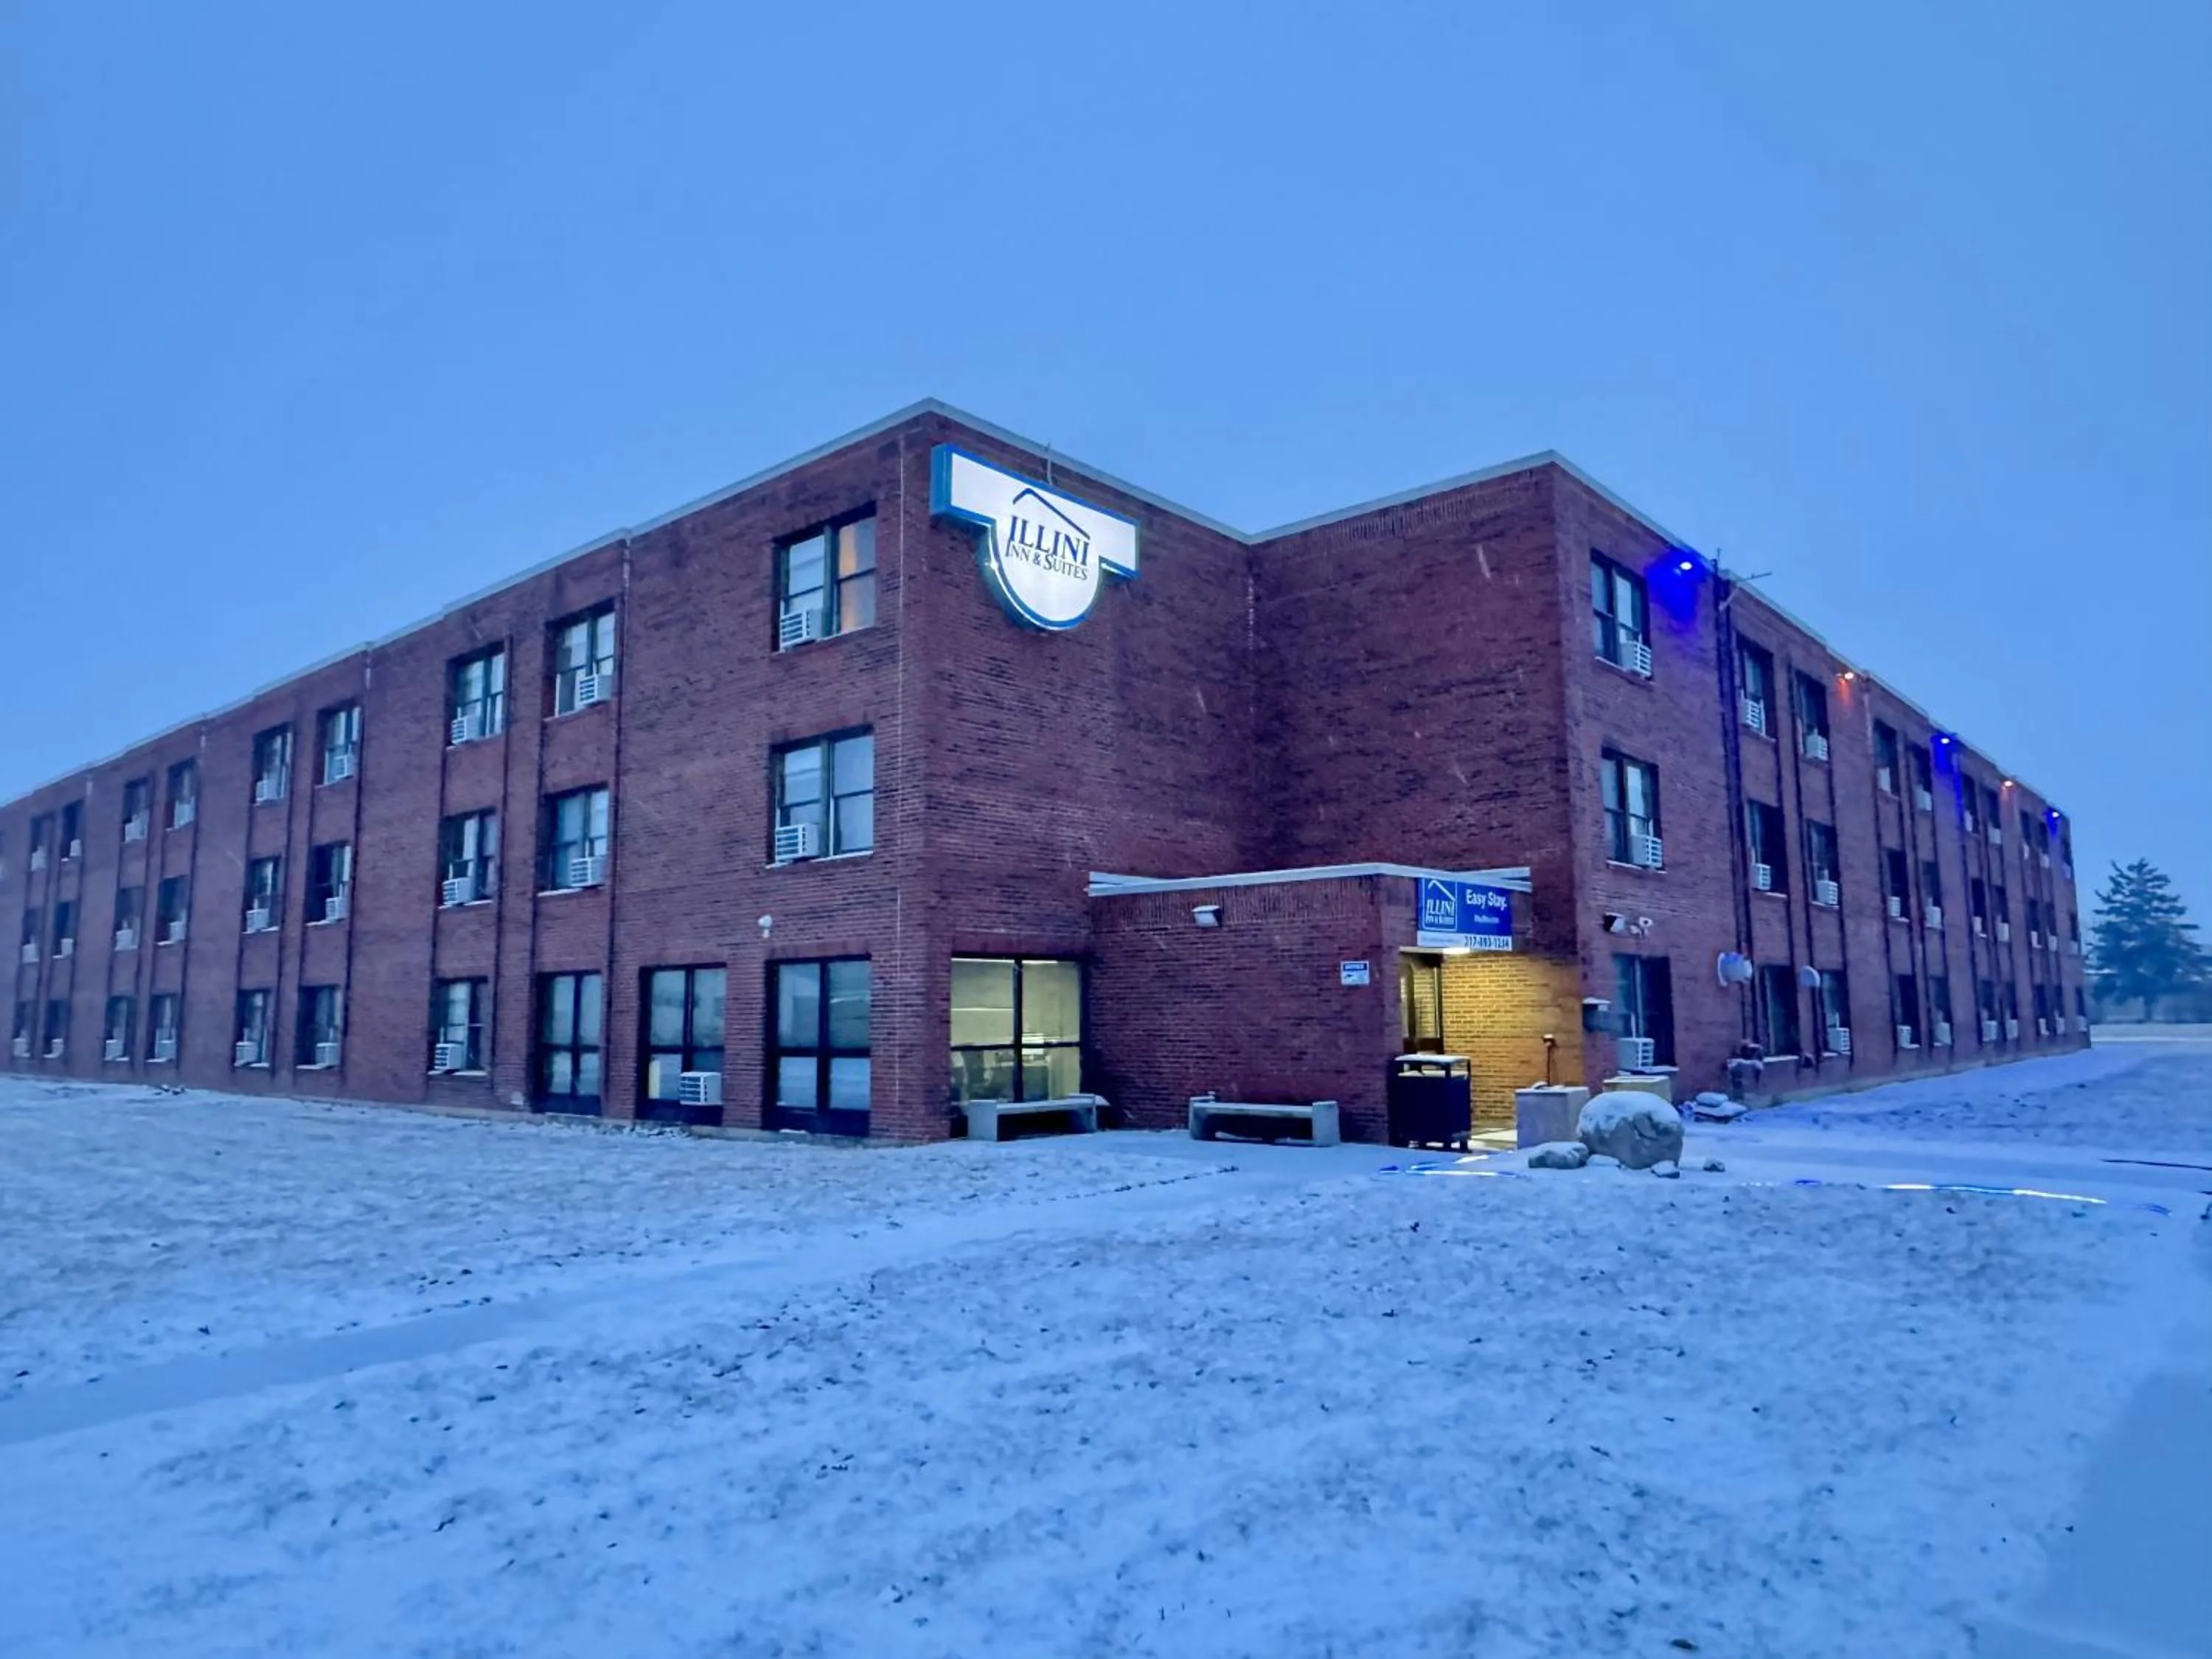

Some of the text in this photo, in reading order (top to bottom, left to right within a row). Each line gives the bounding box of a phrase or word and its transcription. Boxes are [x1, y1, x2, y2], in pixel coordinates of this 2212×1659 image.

[1009, 516, 1090, 566] ILLINI
[1005, 542, 1088, 580] INN & SUITES
[1465, 888, 1486, 909] Easy
